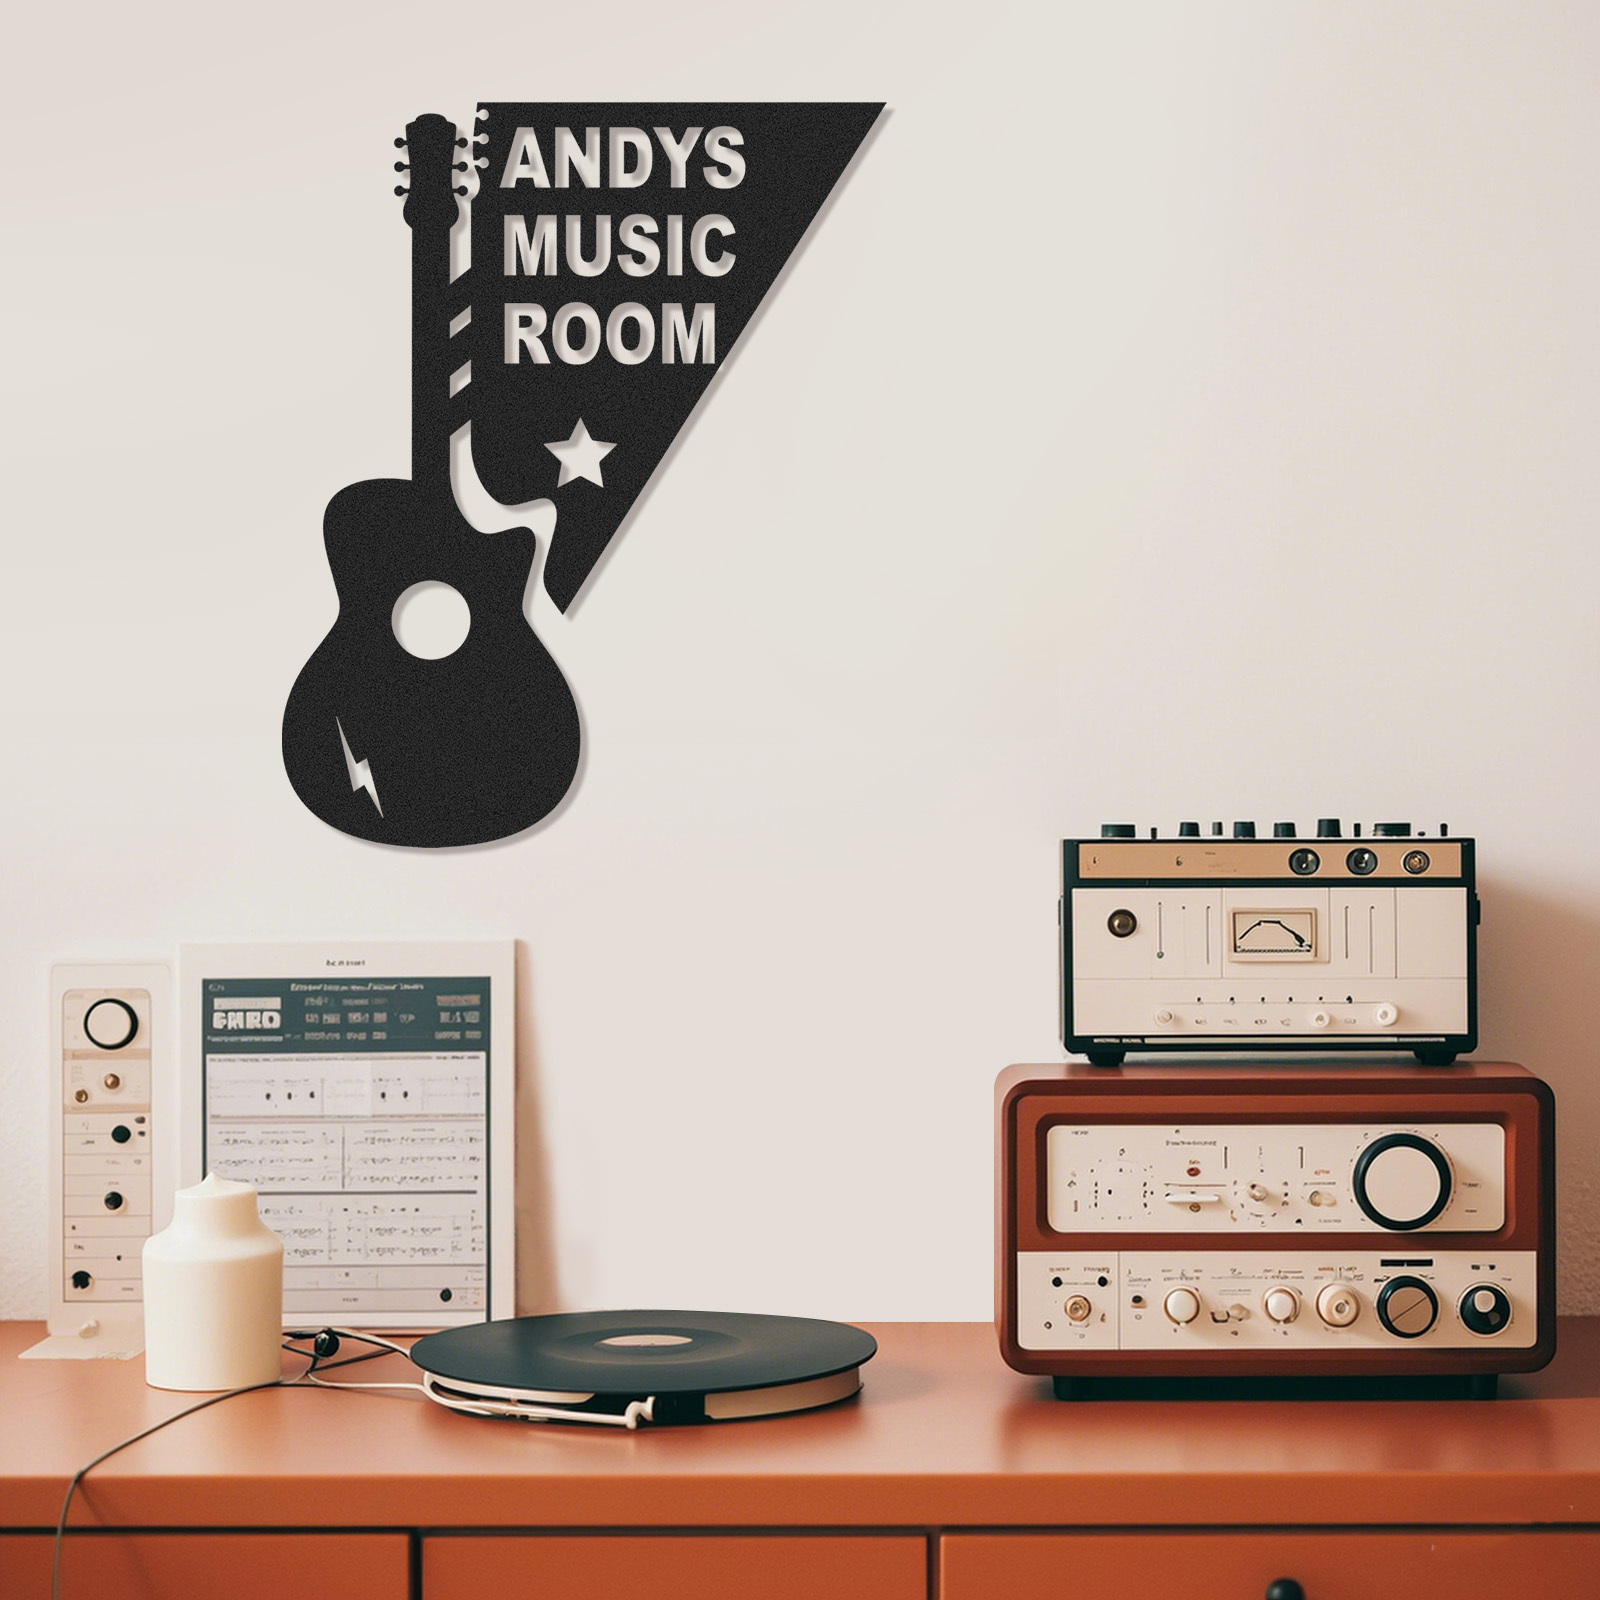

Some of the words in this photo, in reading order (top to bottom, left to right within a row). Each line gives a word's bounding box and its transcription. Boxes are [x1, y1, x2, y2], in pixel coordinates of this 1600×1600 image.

[500, 125, 746, 189] ANDYS
[503, 213, 736, 277] MUSIC
[503, 301, 715, 365] ROOM
